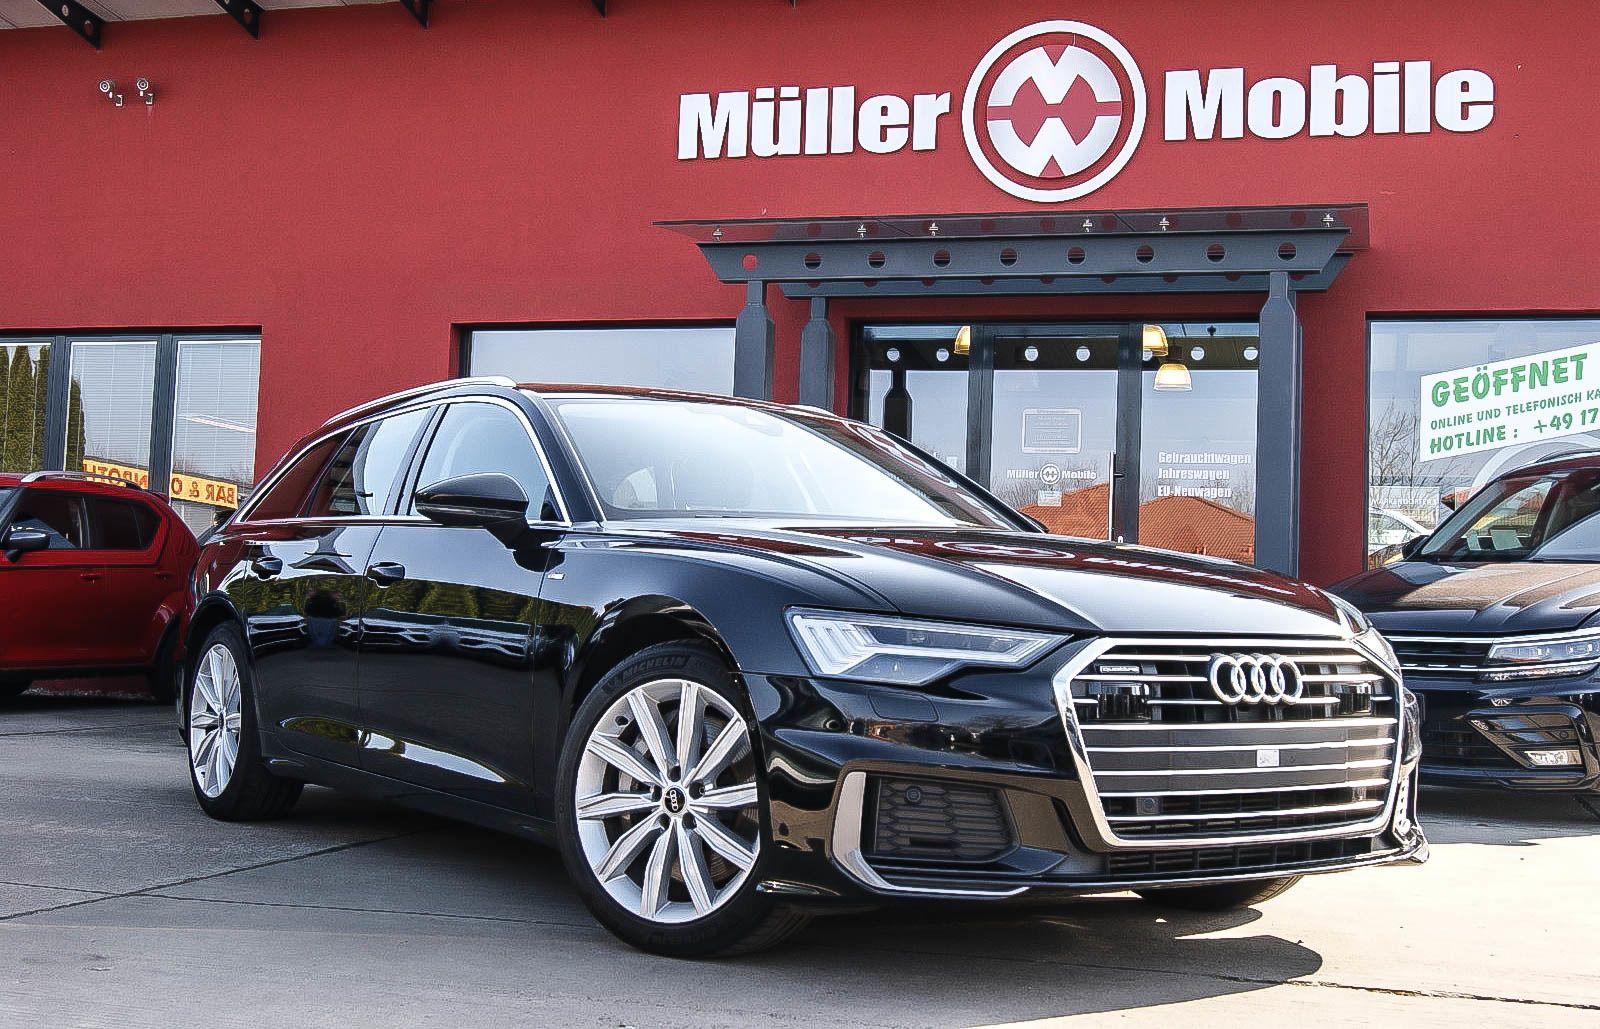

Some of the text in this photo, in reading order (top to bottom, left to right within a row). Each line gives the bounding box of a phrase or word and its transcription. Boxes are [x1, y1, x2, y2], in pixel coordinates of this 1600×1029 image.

[677, 60, 1494, 160] Müller Mobile
[1431, 353, 1588, 407] GEÖFFNET
[1430, 413, 1473, 430] ONLINE
[1477, 408, 1501, 422] UND
[1505, 392, 1582, 416] TELEFONISCH
[1429, 425, 1506, 454] HOTLINE
[1533, 413, 1573, 434] +49
[1580, 407, 1599, 426] 17
[1158, 451, 1251, 465] Gebrauchtwagen
[1006, 468, 1097, 480] Müller Mobile
[1157, 468, 1230, 480] Jahreswagen
[1157, 485, 1233, 499] EU-Neuwagen
